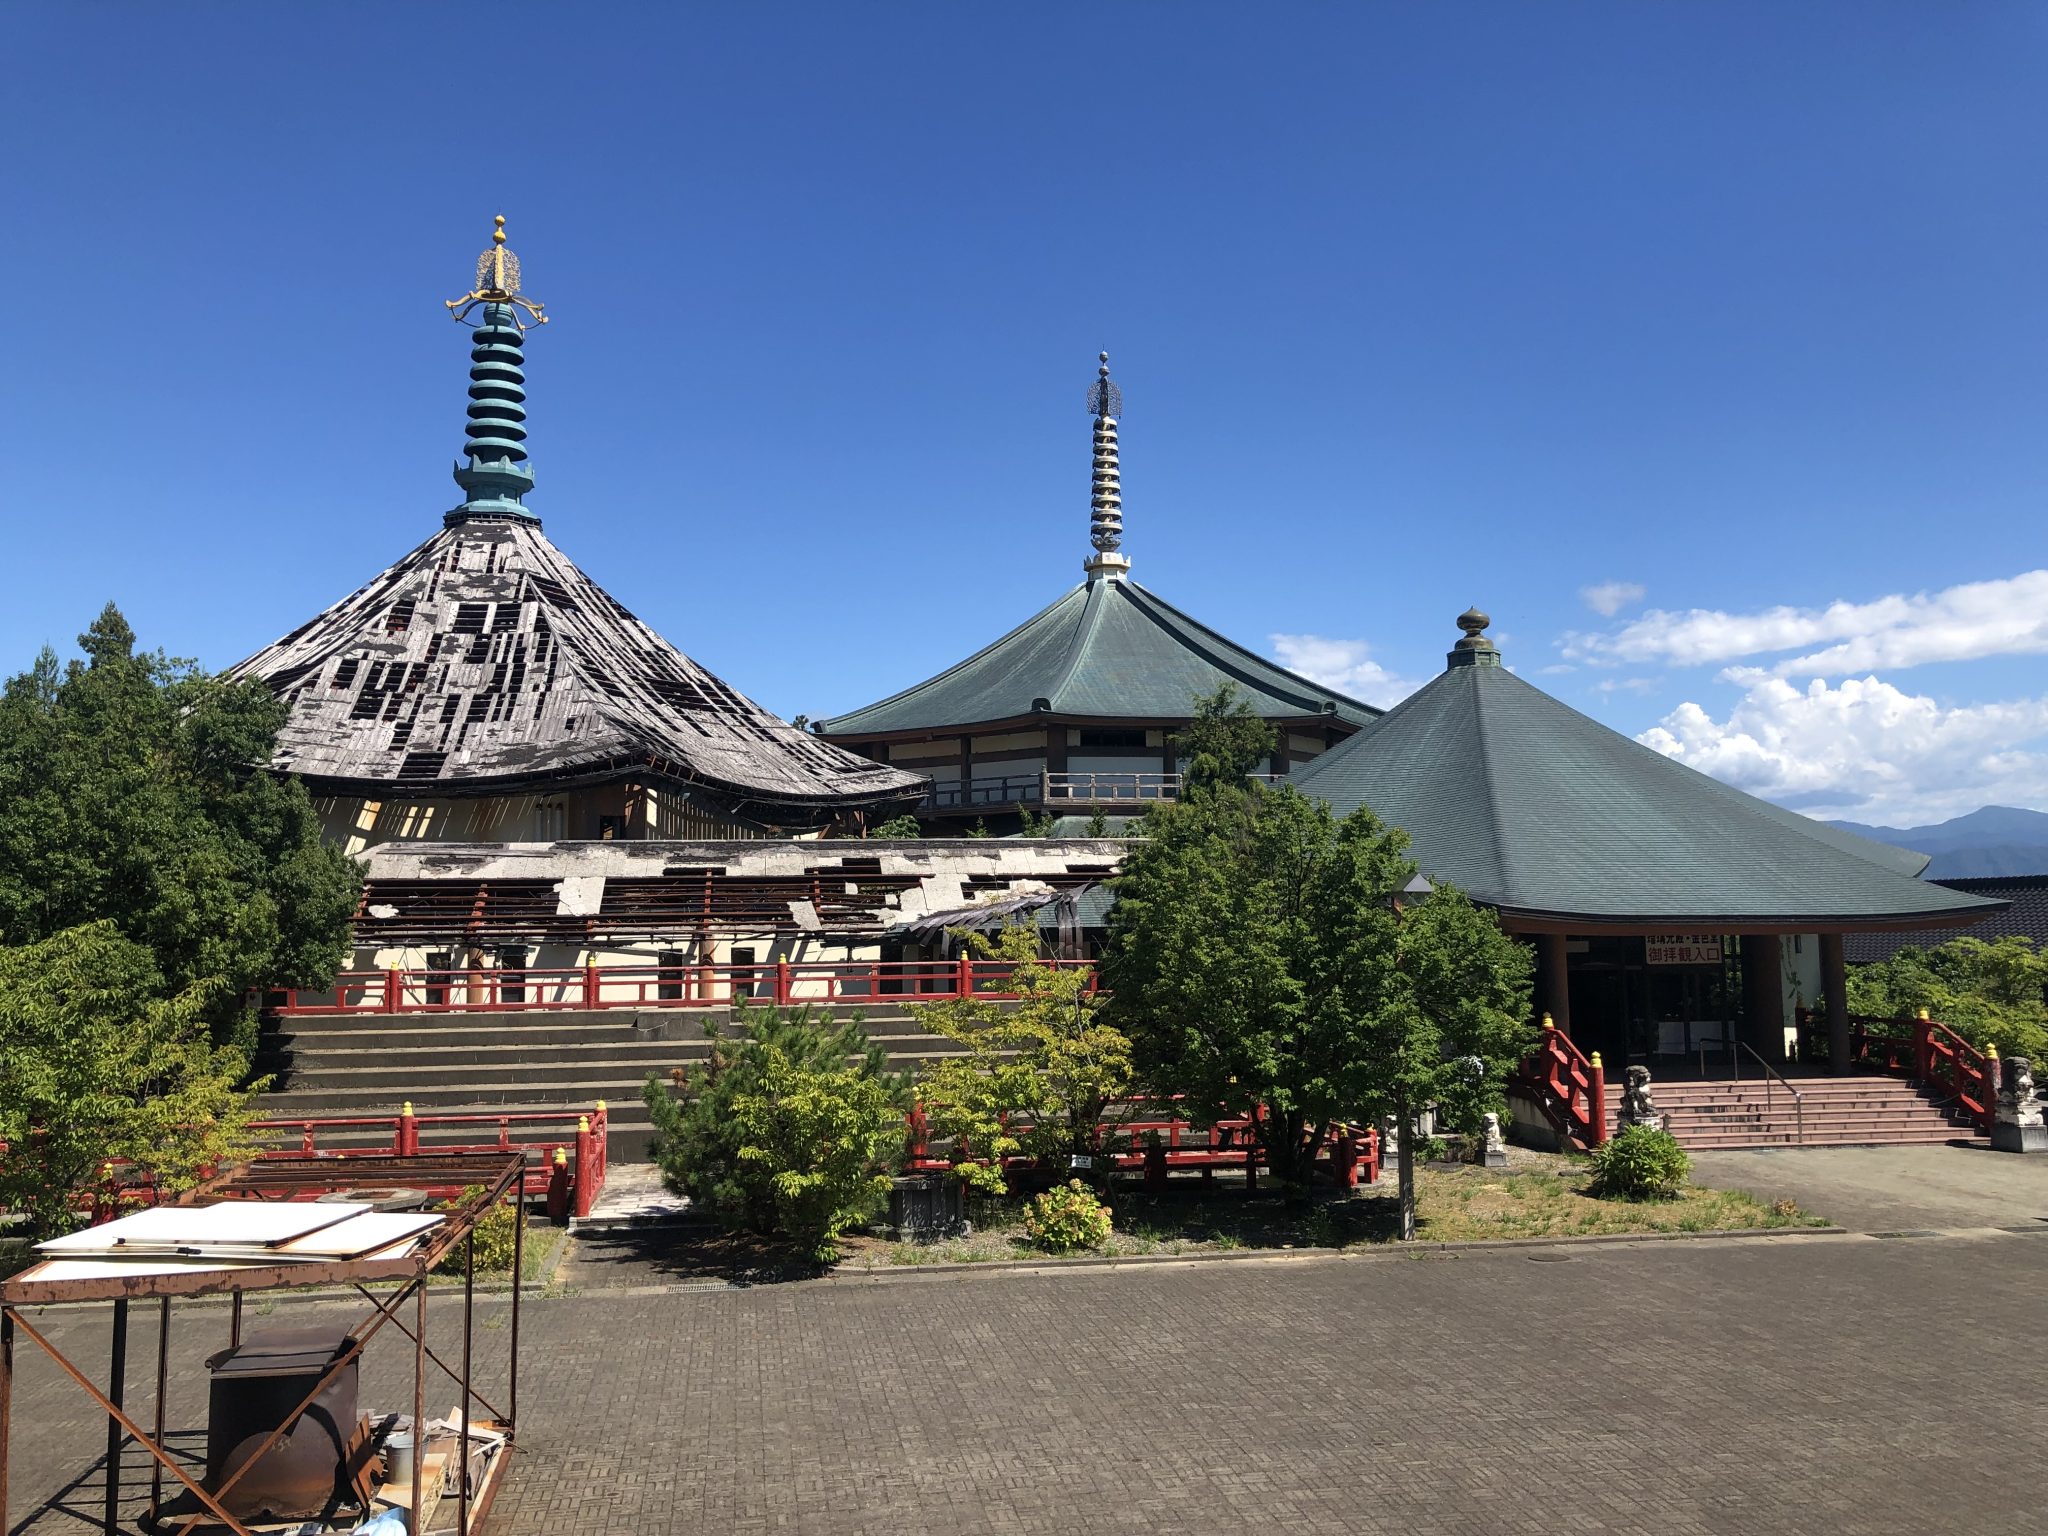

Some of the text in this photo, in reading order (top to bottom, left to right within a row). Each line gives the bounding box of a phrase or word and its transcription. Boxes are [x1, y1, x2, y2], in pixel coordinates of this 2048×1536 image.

[1648, 946, 1720, 962] 御拝観入口
